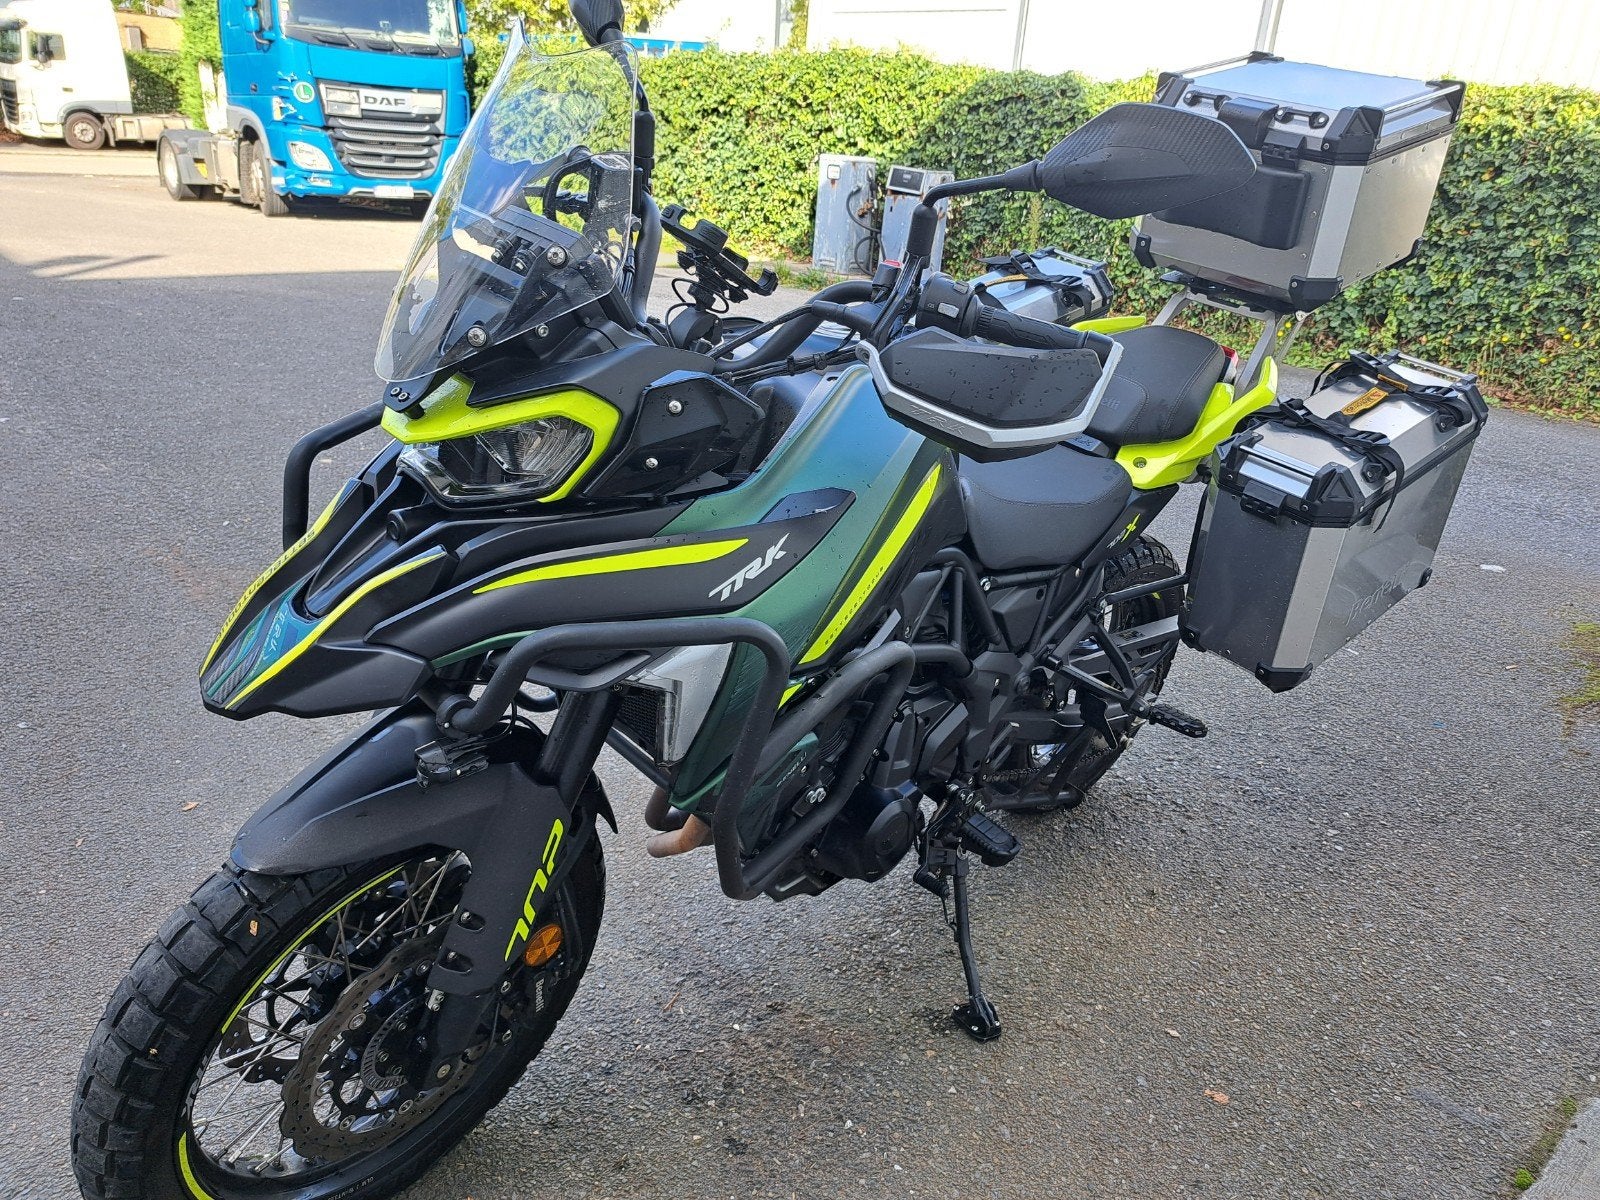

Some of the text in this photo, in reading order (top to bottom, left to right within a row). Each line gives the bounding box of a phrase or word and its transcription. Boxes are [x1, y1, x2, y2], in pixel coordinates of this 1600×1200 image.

[363, 95, 406, 106] DAF
[910, 404, 966, 436] TRK
[708, 532, 790, 602] TRK
[504, 818, 564, 962] 702
[535, 978, 545, 1013] Benelli
